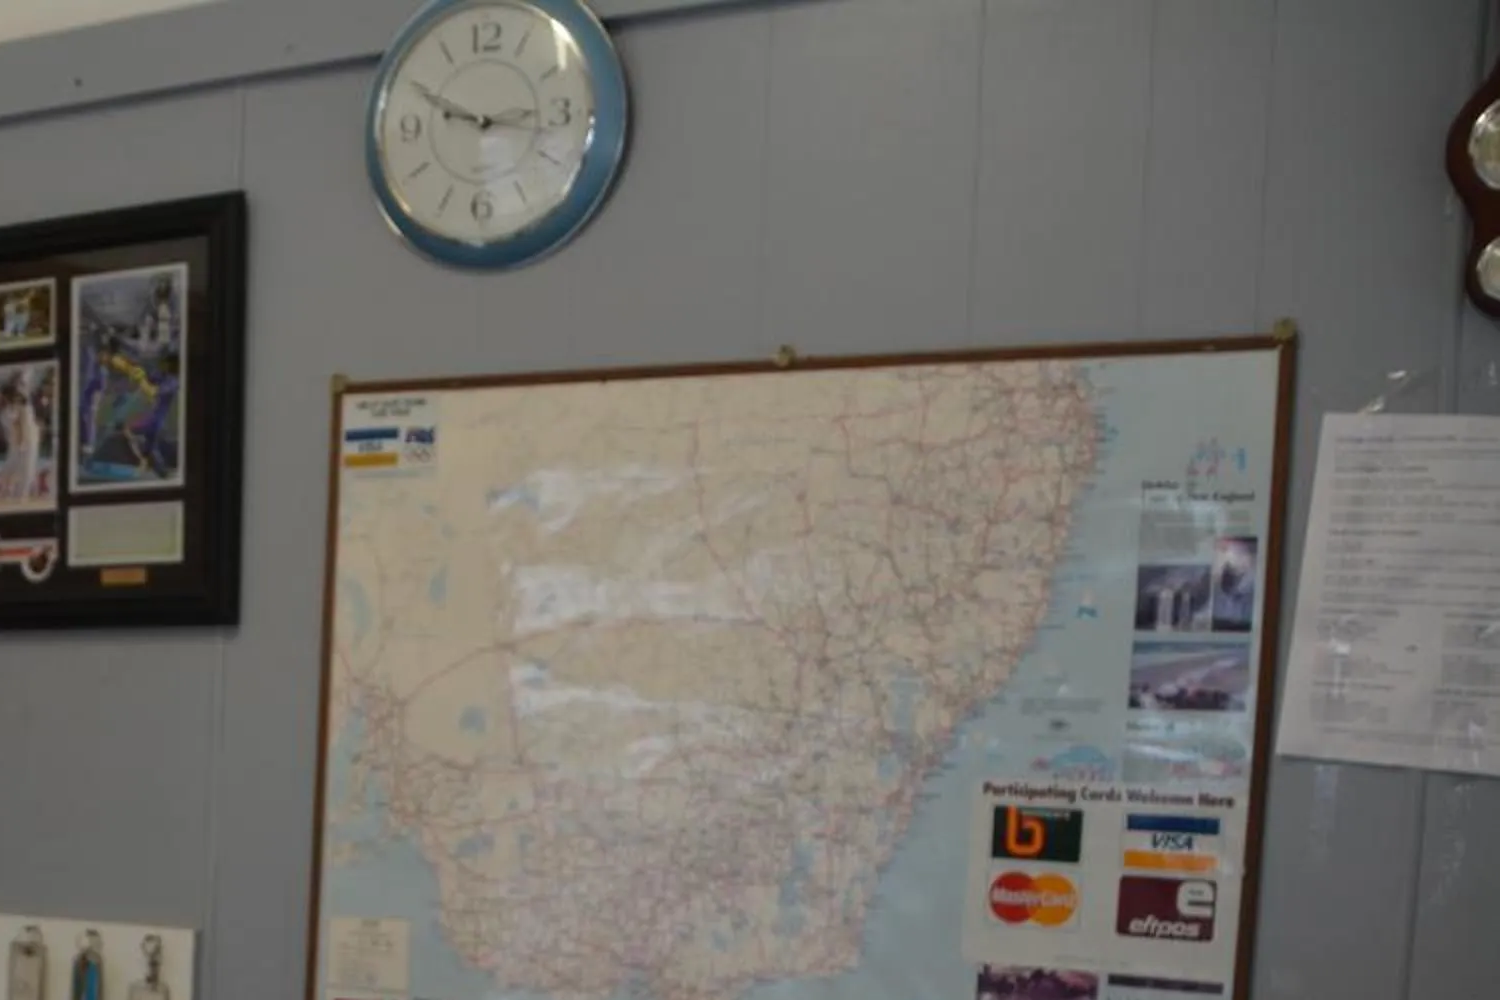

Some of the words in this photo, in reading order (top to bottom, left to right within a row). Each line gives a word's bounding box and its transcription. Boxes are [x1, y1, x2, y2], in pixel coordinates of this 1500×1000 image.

[470, 23, 503, 54] 12
[547, 97, 572, 128] 3
[400, 114, 422, 143] 9
[470, 190, 495, 222] 6
[982, 781, 1077, 803] Participating
[1080, 787, 1122, 802] Cards
[1126, 789, 1194, 806] Welcome
[1197, 794, 1237, 809] Here
[1151, 833, 1195, 851] VISA
[1128, 914, 1201, 938] eftpos
